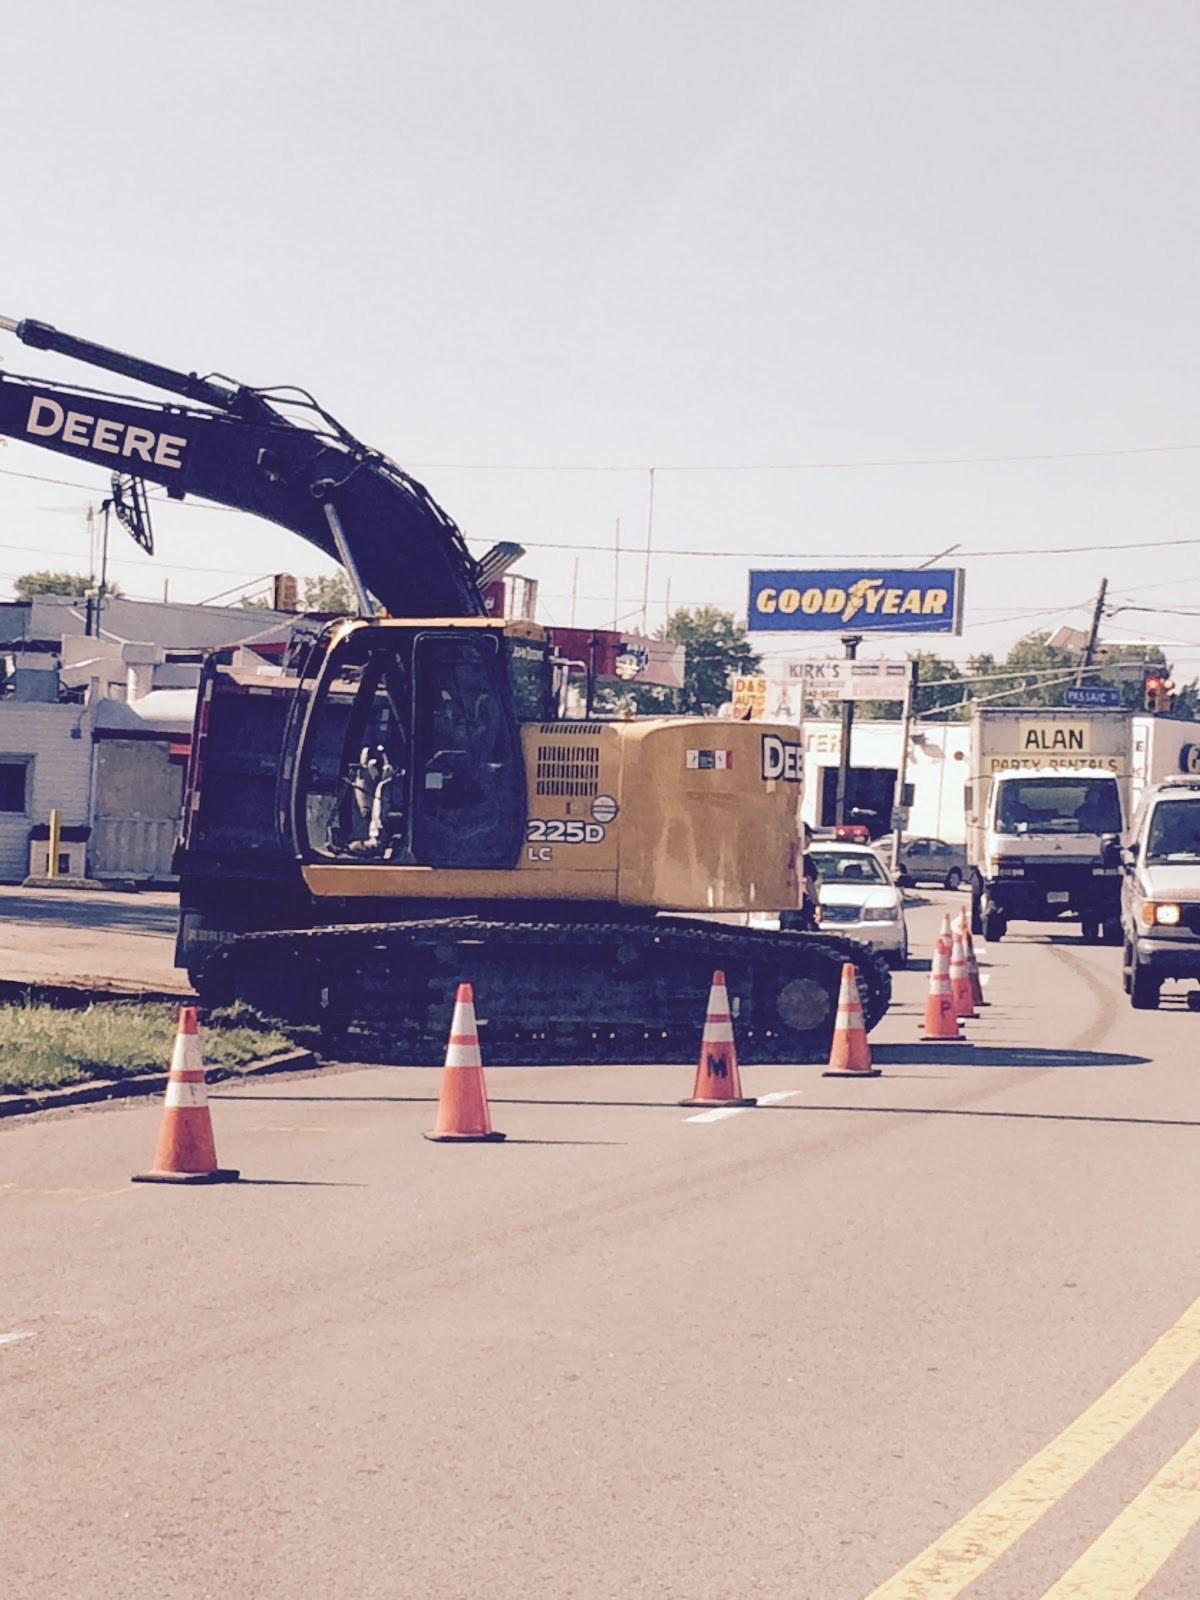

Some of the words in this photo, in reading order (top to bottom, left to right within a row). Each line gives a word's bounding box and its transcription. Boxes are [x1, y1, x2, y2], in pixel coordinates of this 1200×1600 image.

[26, 396, 187, 469] DEERE
[756, 586, 948, 615] GOODYEAR
[789, 664, 840, 679] KIRK'S
[1025, 729, 1084, 750] ALAN
[526, 819, 606, 843] 225D
[527, 846, 552, 862] LC
[707, 1053, 729, 1079] M
